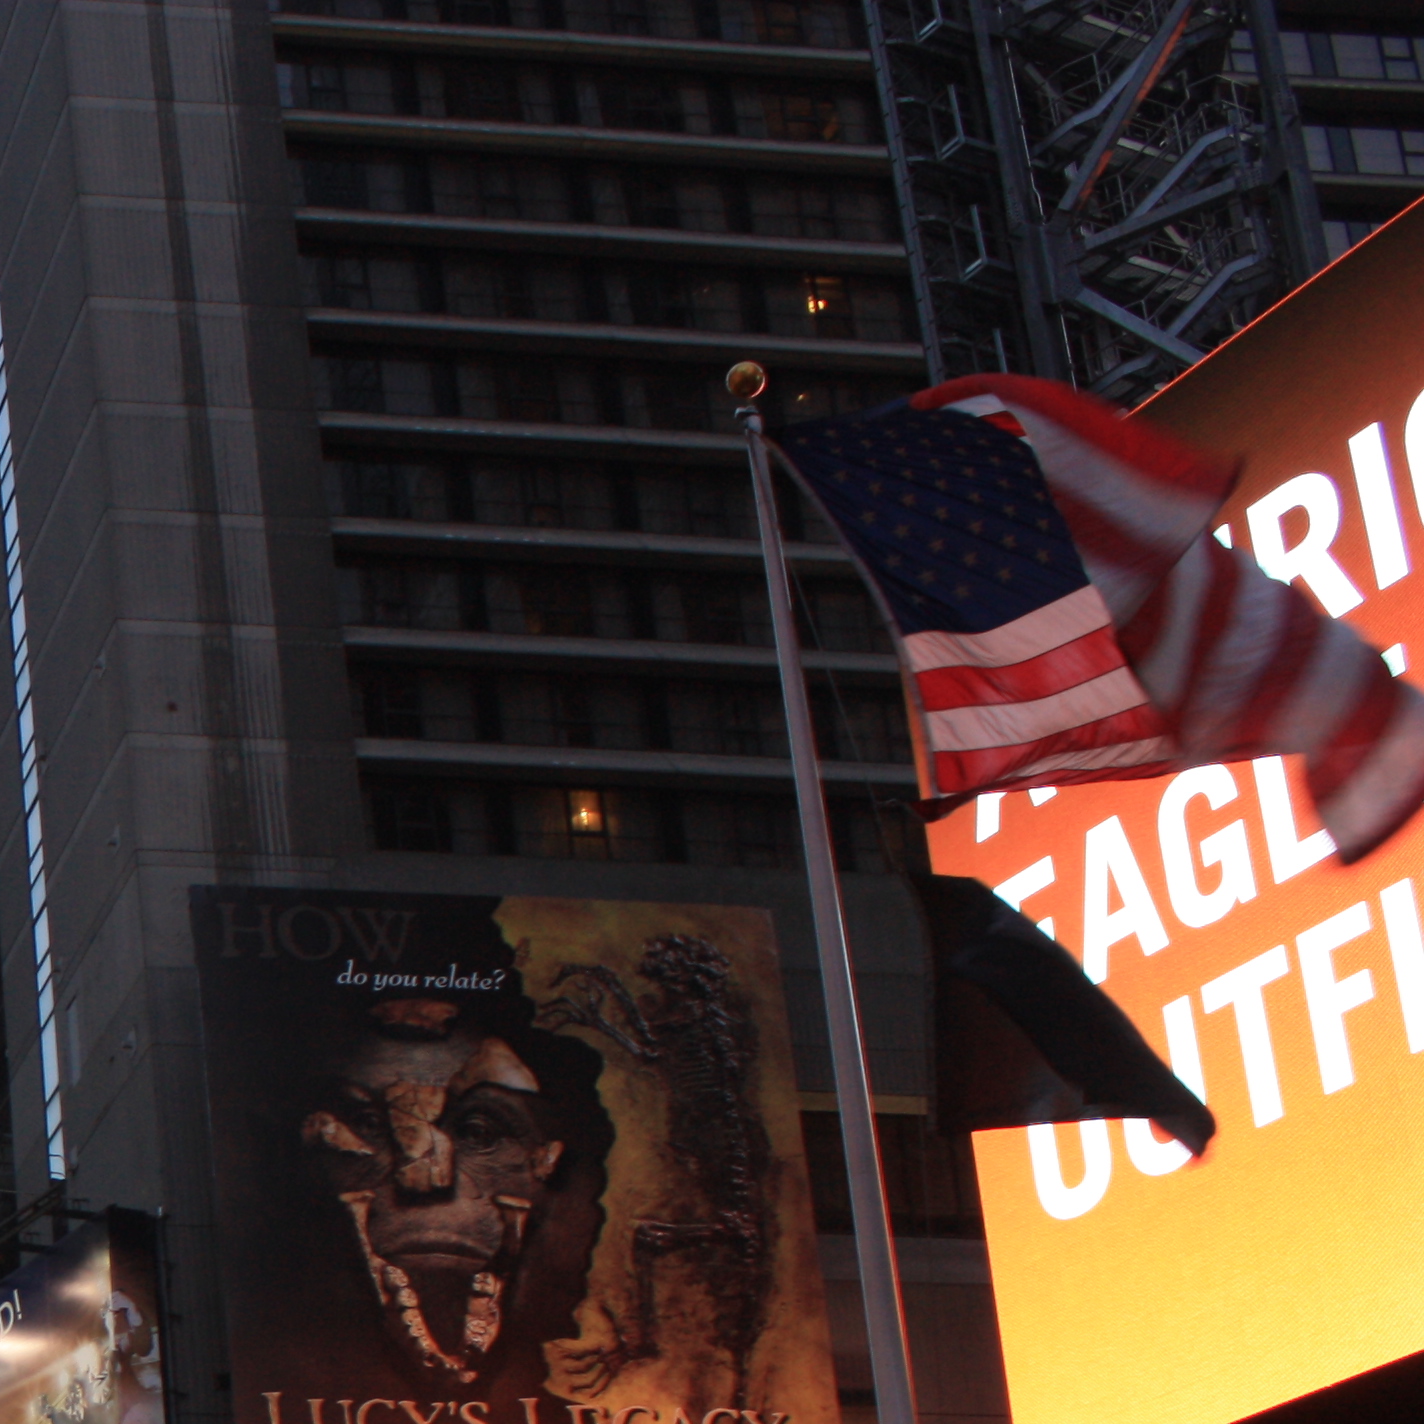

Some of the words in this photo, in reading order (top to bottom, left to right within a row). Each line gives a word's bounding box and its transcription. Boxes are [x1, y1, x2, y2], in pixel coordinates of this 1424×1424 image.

[215, 902, 422, 962] HOW
[337, 960, 367, 985] do
[374, 974, 418, 991] you
[424, 964, 505, 990] relate?
